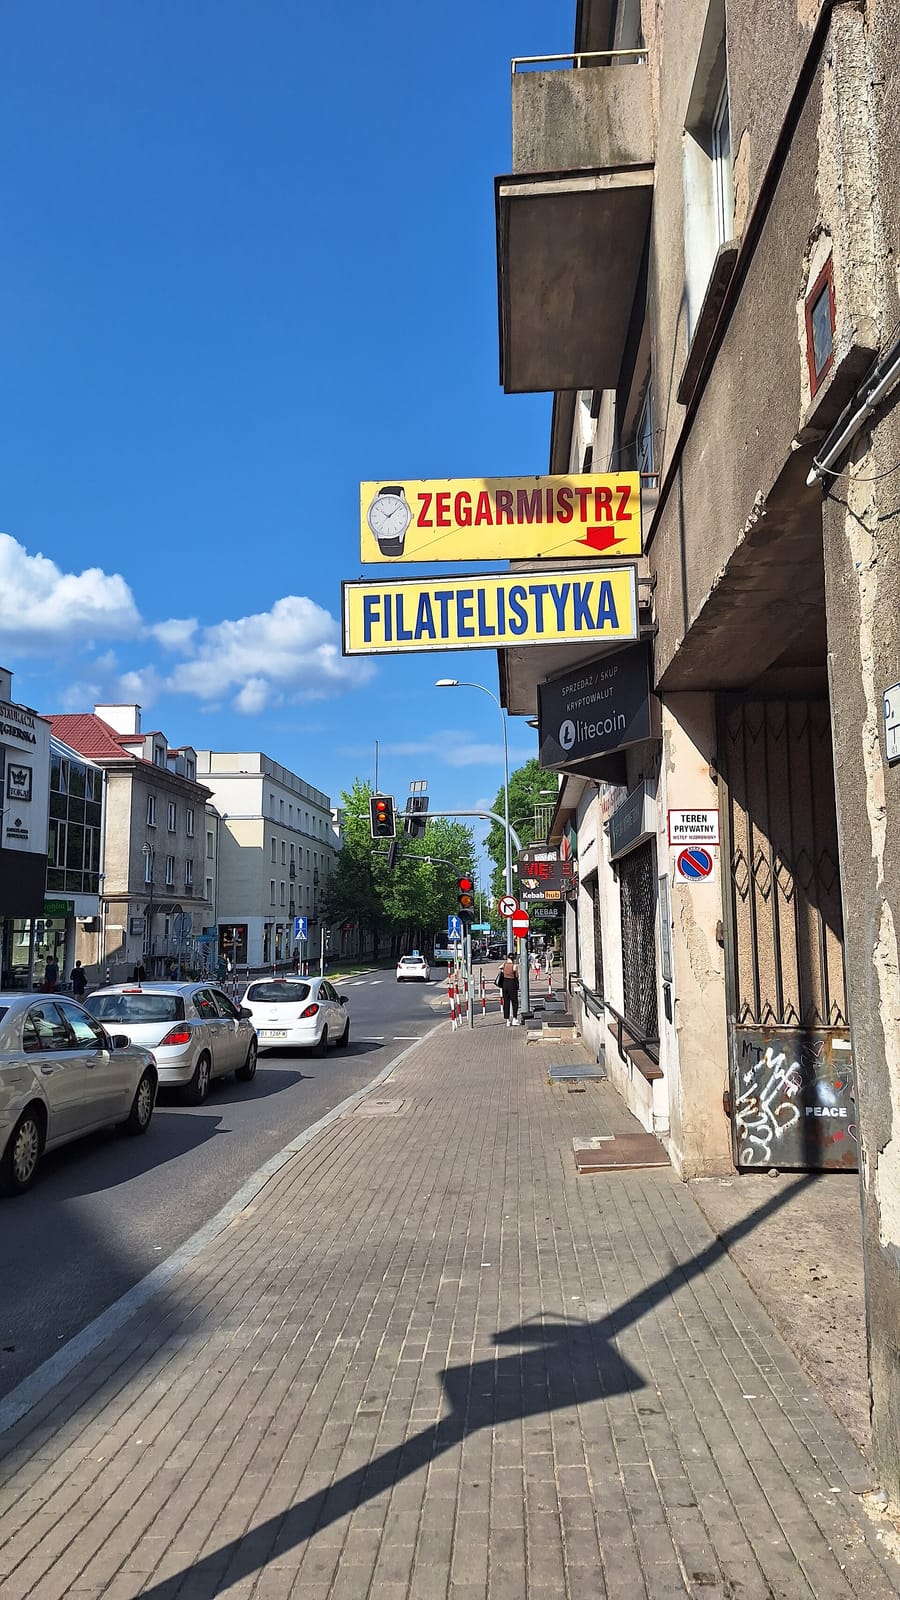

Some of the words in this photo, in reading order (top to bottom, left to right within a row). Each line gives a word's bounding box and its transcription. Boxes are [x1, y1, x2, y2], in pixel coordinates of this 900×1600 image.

[416, 485, 632, 528] ZEGARMISTRZ
[363, 580, 619, 643] FILATELISTYKA
[600, 666, 618, 681] SKUP
[566, 686, 614, 713] KRYPTOWALUT
[576, 709, 627, 743] litecoin
[674, 824, 715, 833] PRYWATNY
[681, 814, 708, 823] TEREN
[805, 1107, 848, 1117] PEACE
